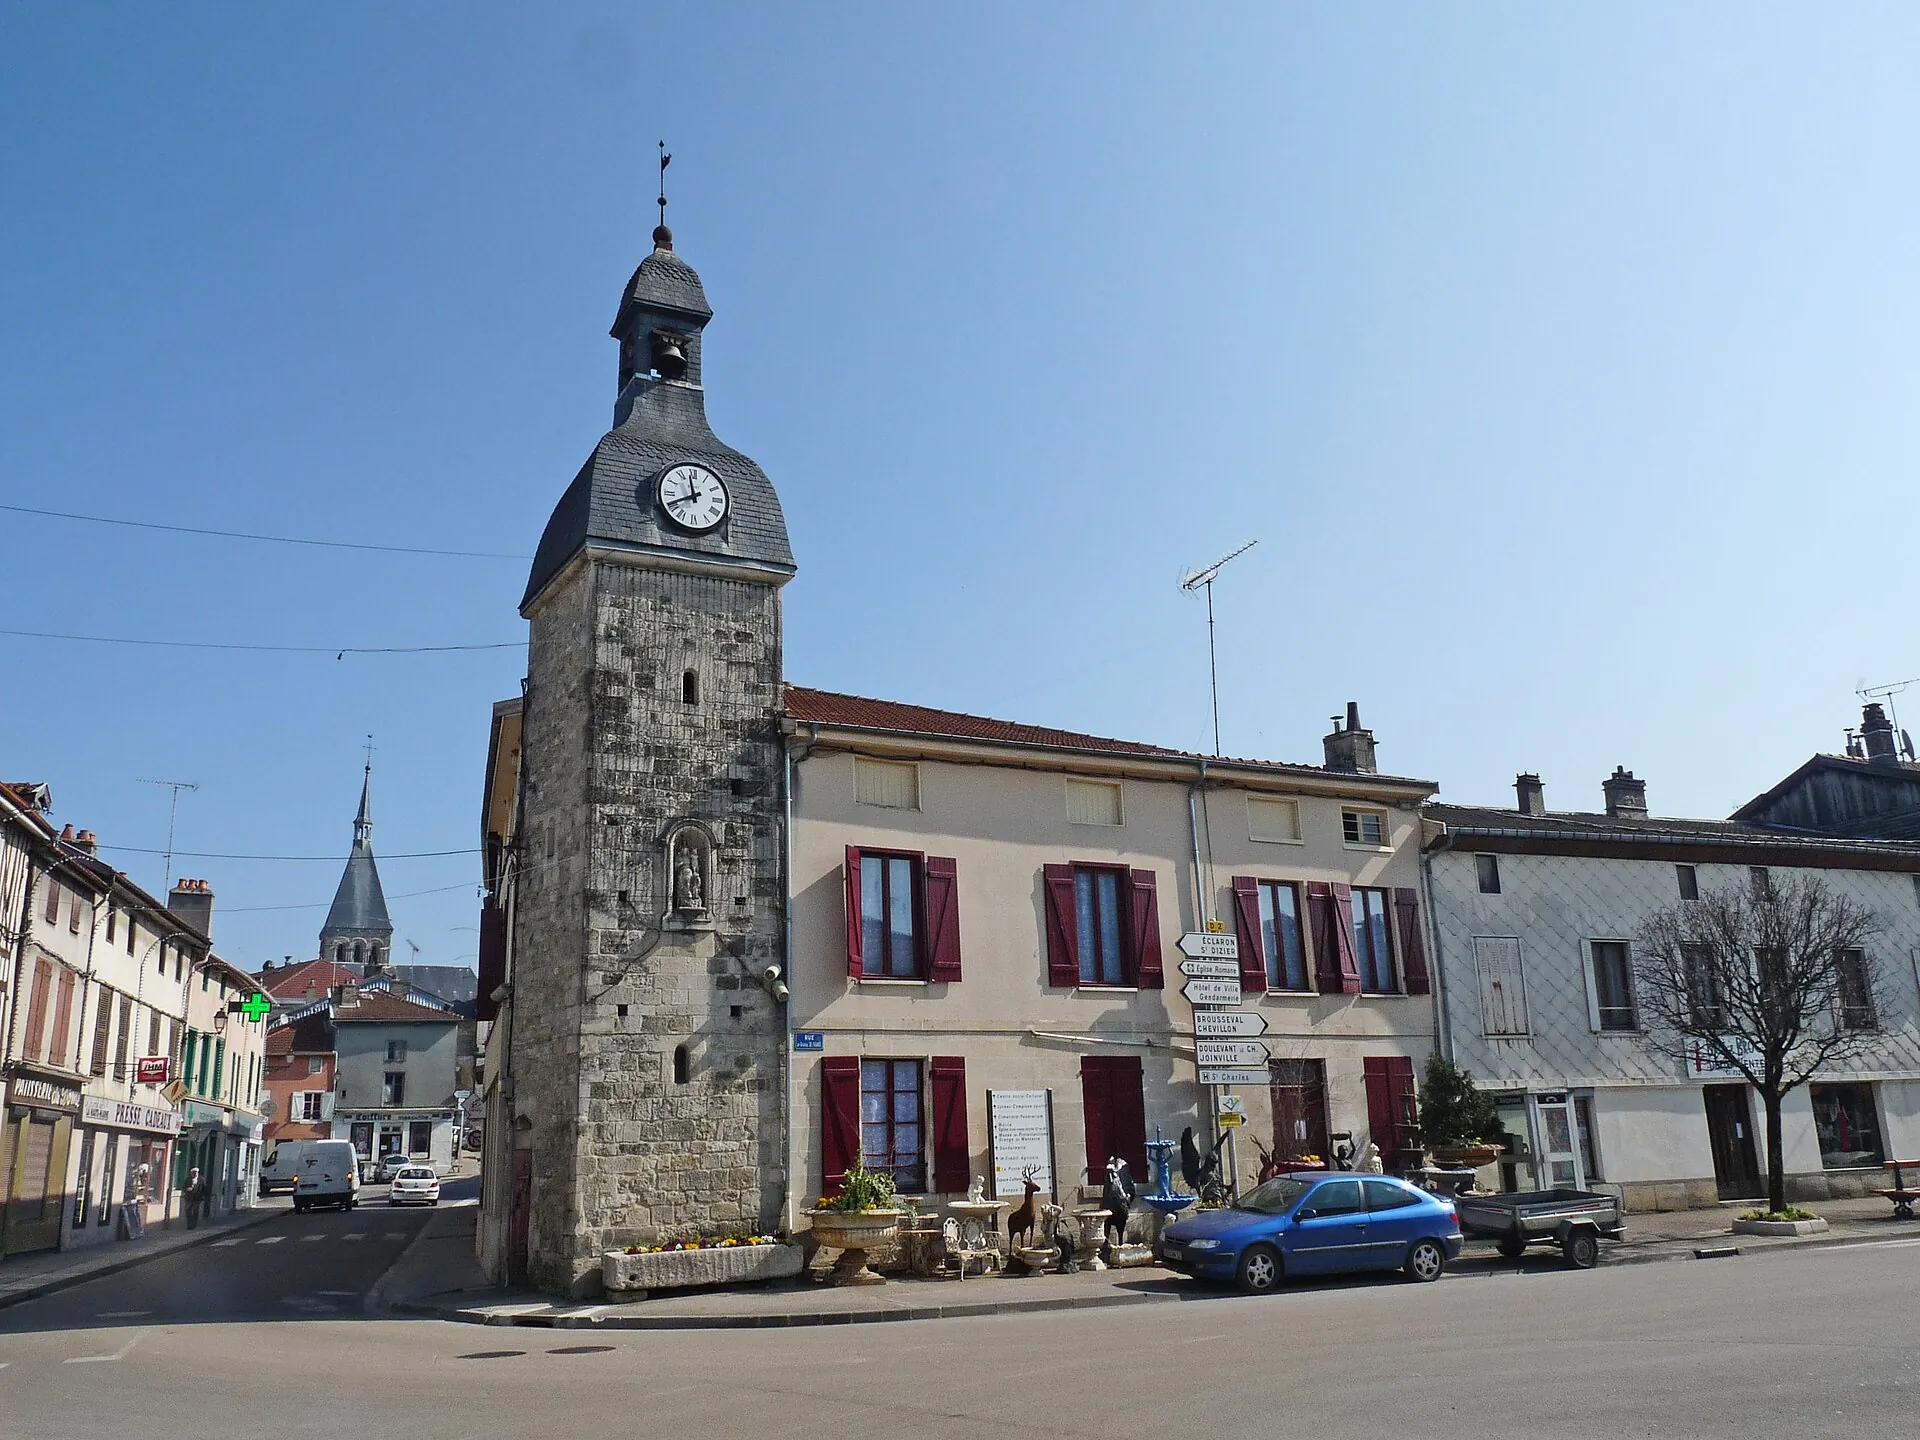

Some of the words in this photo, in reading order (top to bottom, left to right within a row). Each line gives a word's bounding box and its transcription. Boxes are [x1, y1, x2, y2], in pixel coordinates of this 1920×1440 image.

[1202, 936, 1235, 946] ÉCLARON
[1214, 966, 1236, 974] Romane
[1200, 992, 1239, 1002] Gendarmerie
[1196, 1015, 1244, 1024] BROUSSEVAL
[114, 1104, 142, 1126] PRESSE
[145, 1109, 172, 1130] CADEAUX
